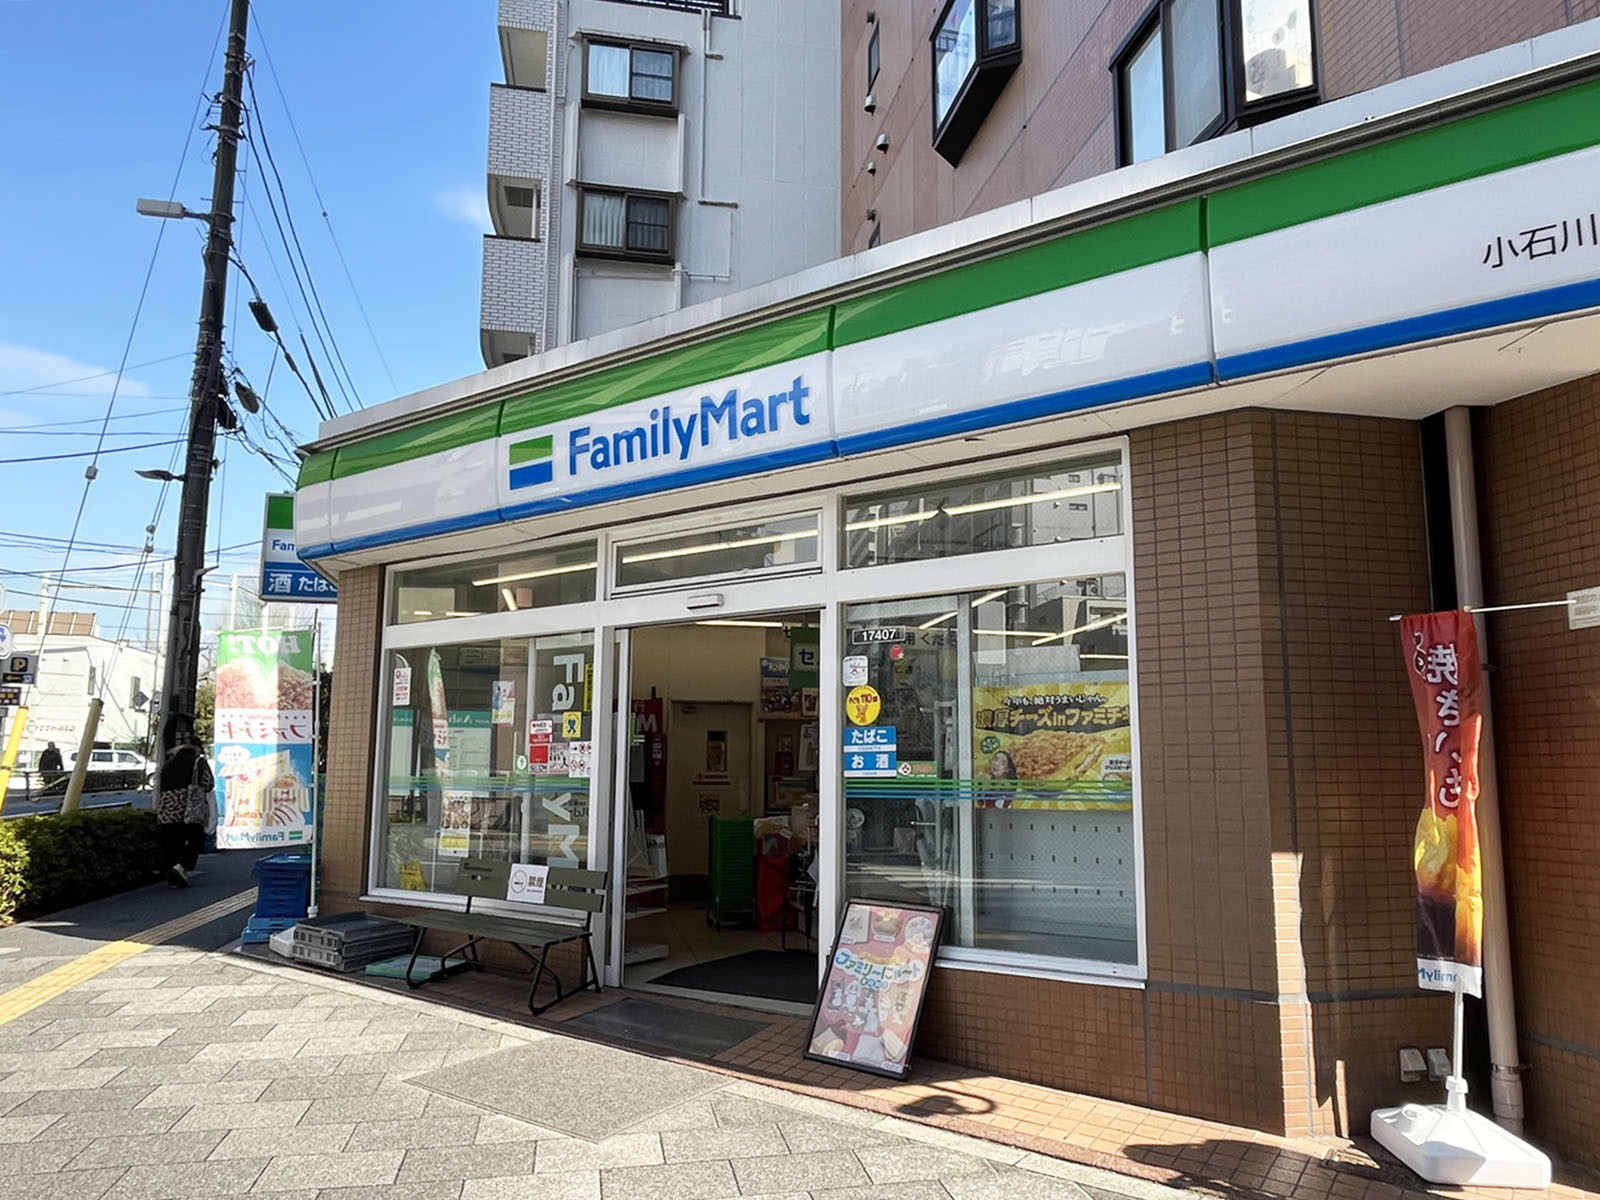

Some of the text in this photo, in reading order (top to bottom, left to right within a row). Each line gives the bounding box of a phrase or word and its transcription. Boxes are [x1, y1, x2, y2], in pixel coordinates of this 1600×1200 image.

[1482, 213, 1598, 269] 小石川
[569, 375, 810, 477] FamilyMart
[268, 573, 292, 593] 酒
[862, 628, 896, 641] 17407
[851, 729, 888, 744] たばこ
